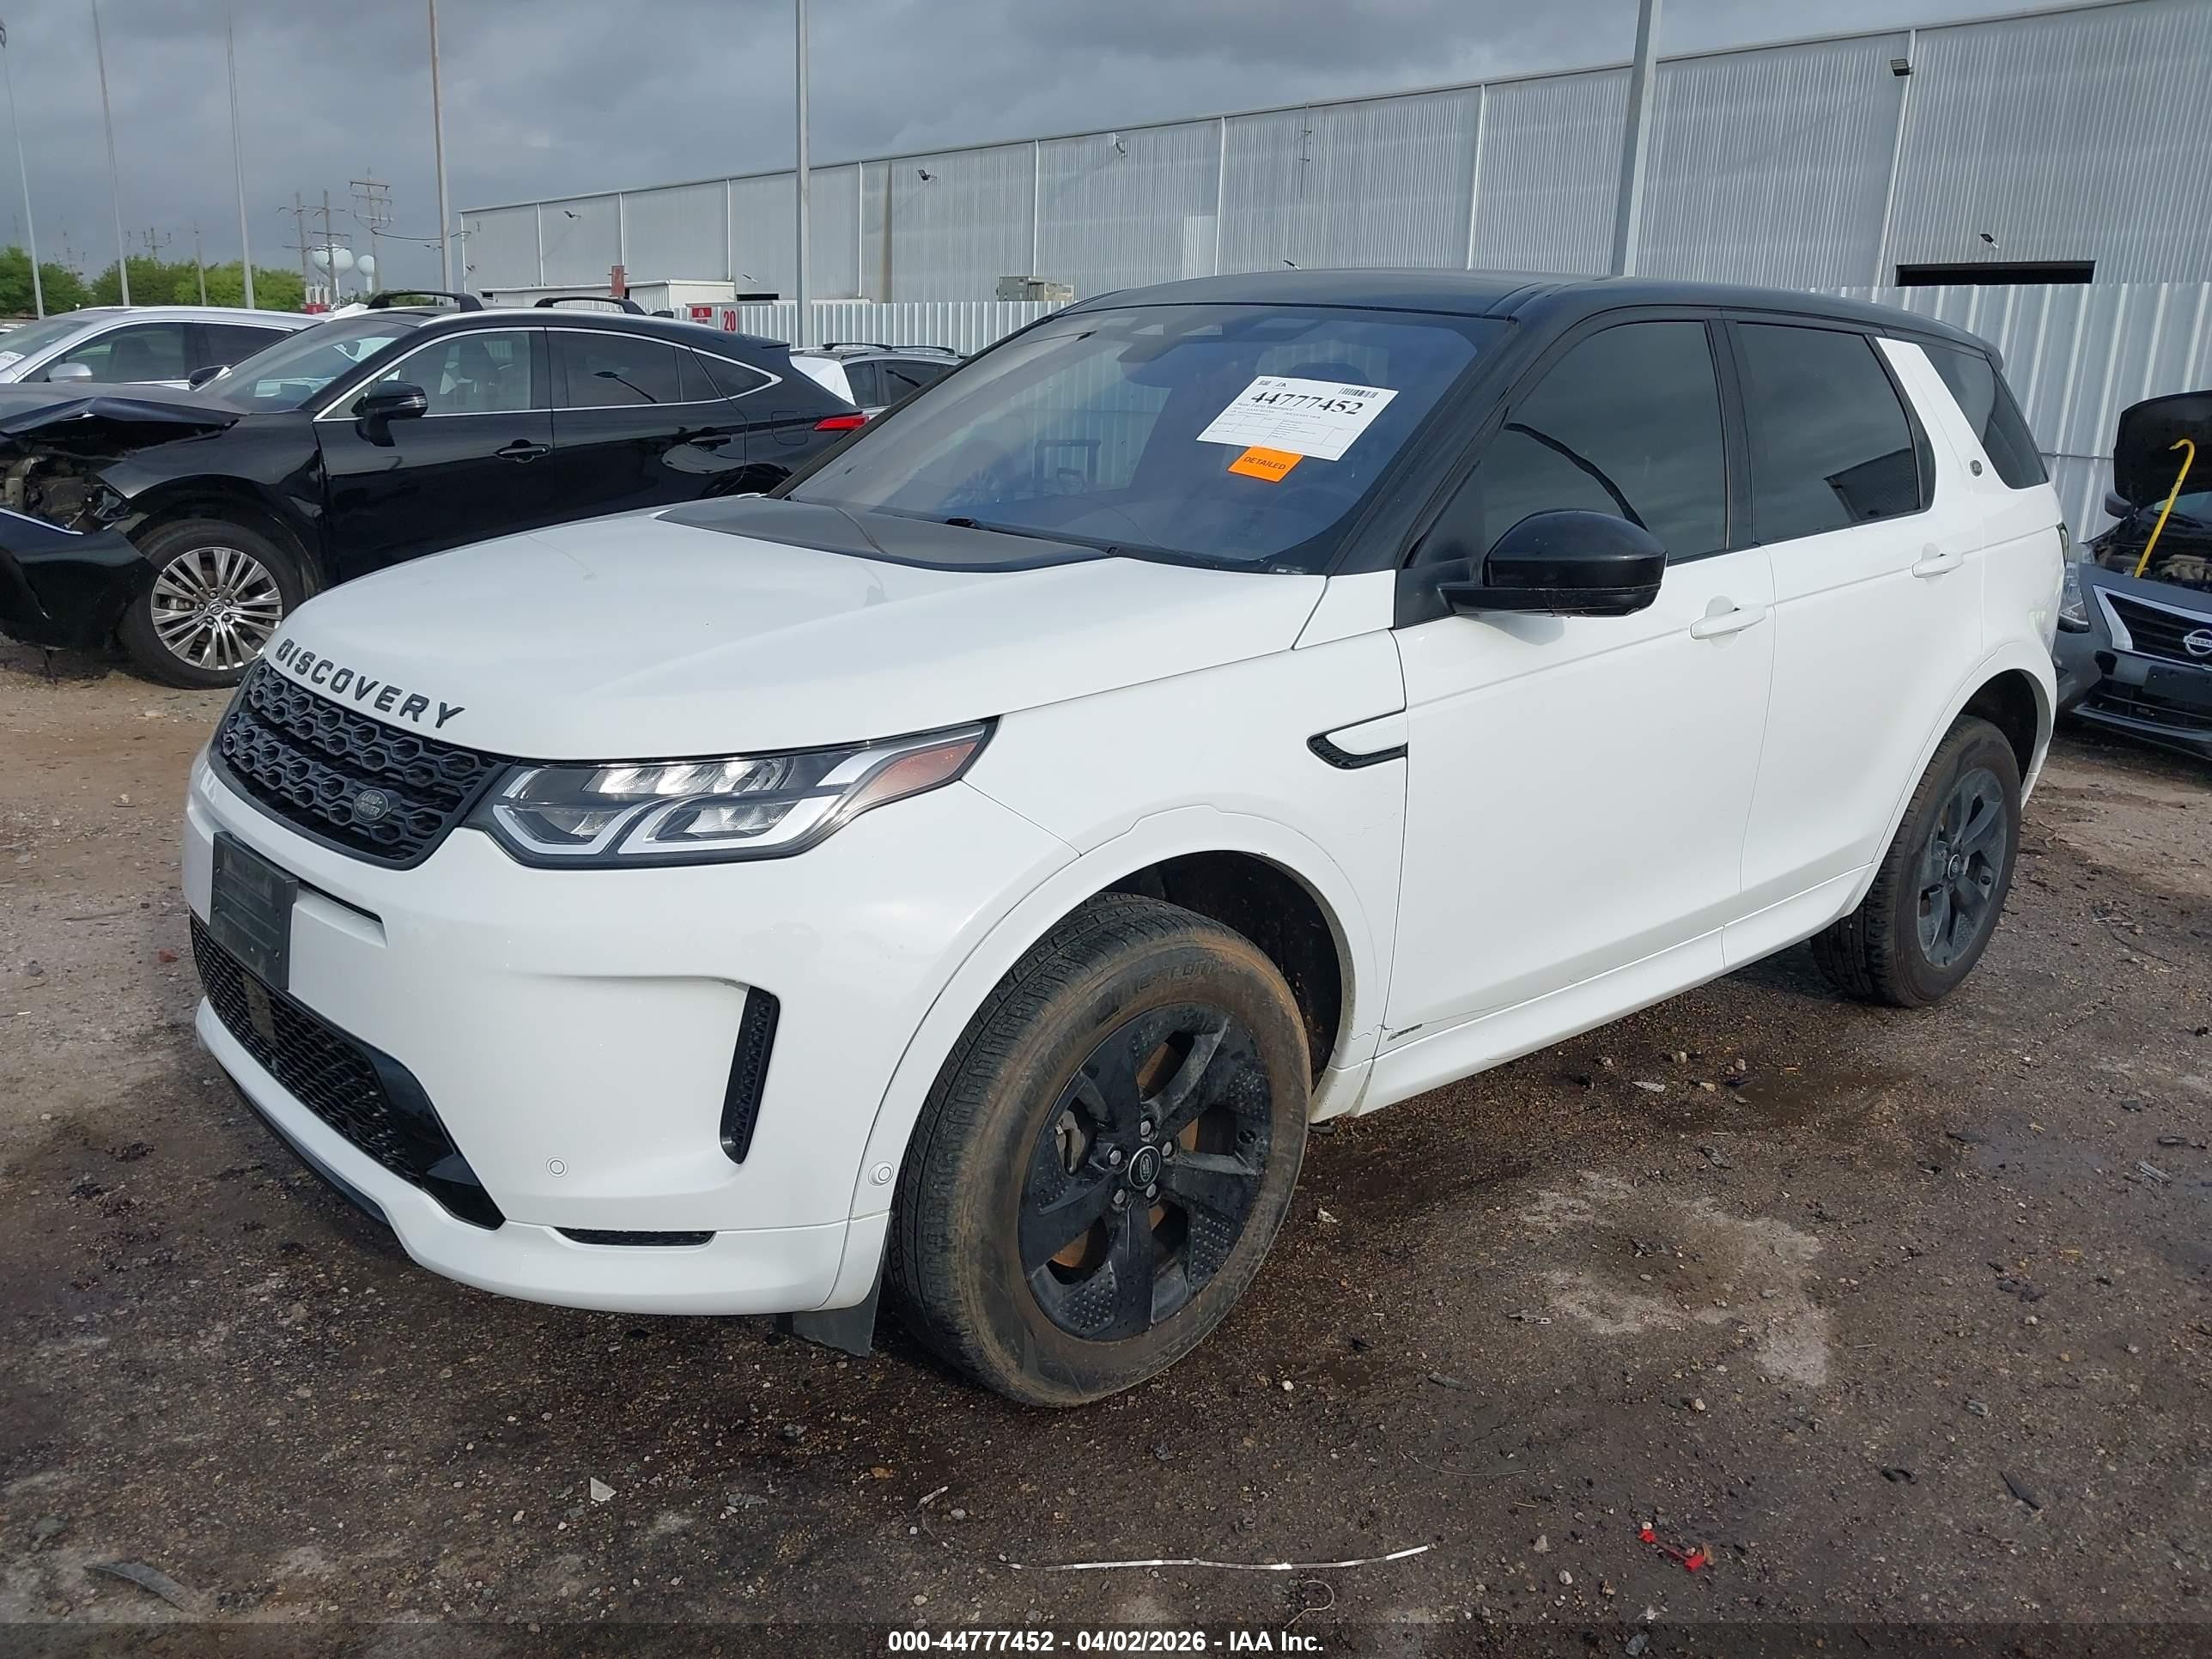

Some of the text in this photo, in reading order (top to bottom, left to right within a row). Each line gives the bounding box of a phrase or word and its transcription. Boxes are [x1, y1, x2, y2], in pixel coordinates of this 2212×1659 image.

[723, 309, 737, 331] 20
[1251, 392, 1364, 415] 44777452
[1243, 456, 1286, 470] DETAILED
[2186, 636, 2212, 647] NISSA
[275, 638, 465, 729] DISCOVERY
